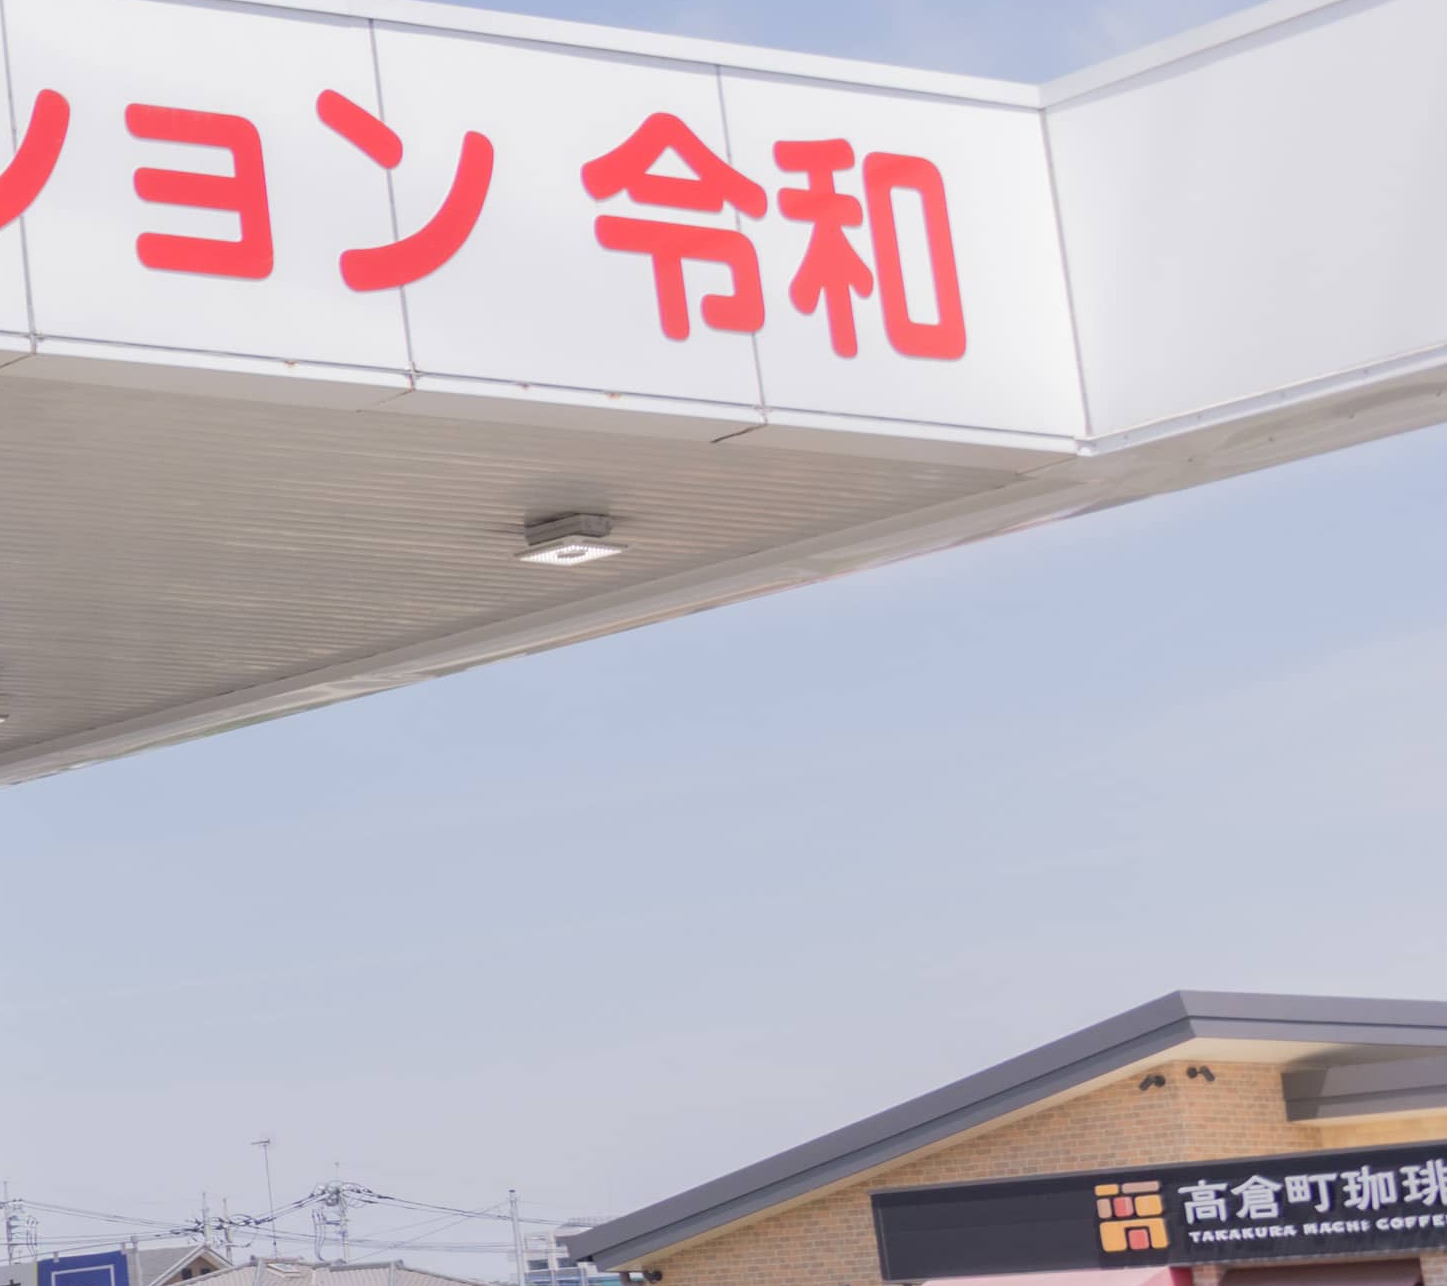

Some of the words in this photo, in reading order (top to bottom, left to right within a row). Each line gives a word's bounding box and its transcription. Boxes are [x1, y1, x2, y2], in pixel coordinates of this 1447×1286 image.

[579, 111, 967, 362] 令和
[1188, 1224, 1297, 1244] TAKAKURA
[1303, 1219, 1370, 1236] MACHI
[1376, 1213, 1447, 1232] COFFE
